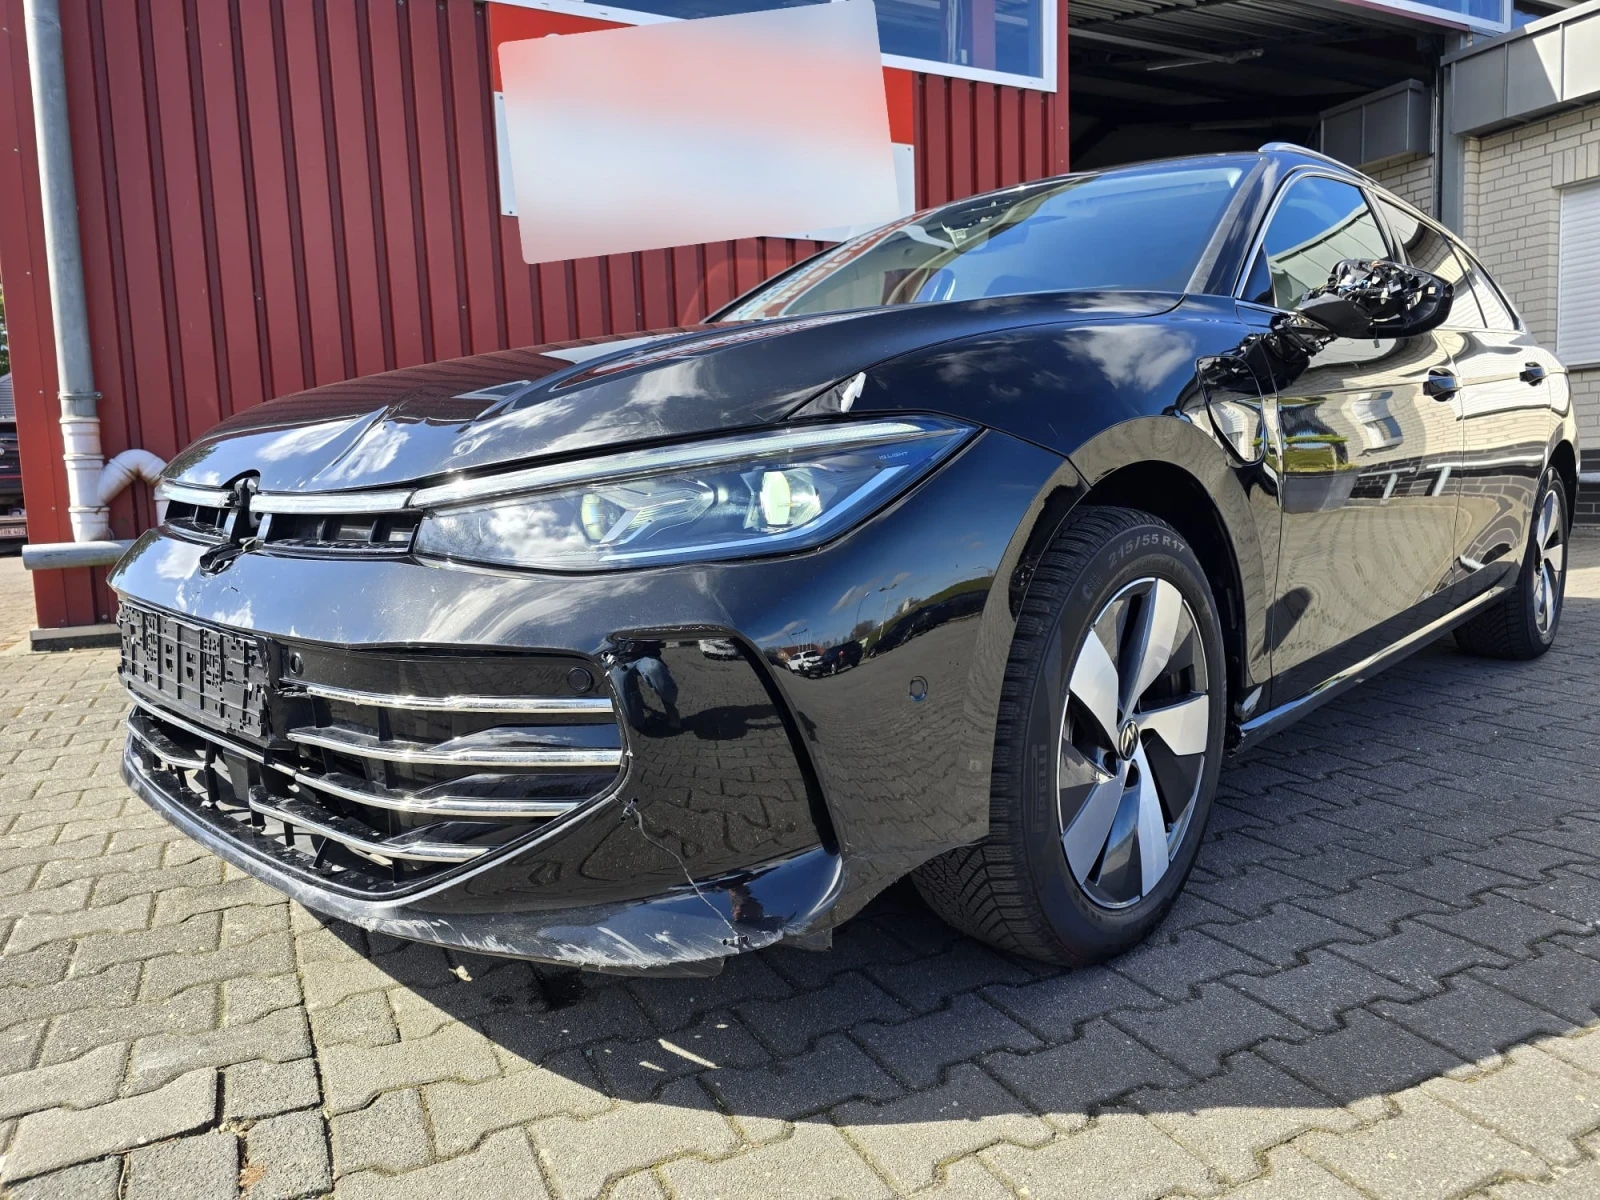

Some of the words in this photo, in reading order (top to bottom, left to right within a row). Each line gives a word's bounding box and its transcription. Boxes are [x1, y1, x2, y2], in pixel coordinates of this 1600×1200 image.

[1108, 533, 1159, 570] 215/55
[1162, 534, 1186, 553] R17
[1031, 743, 1048, 834] PIRELLI
